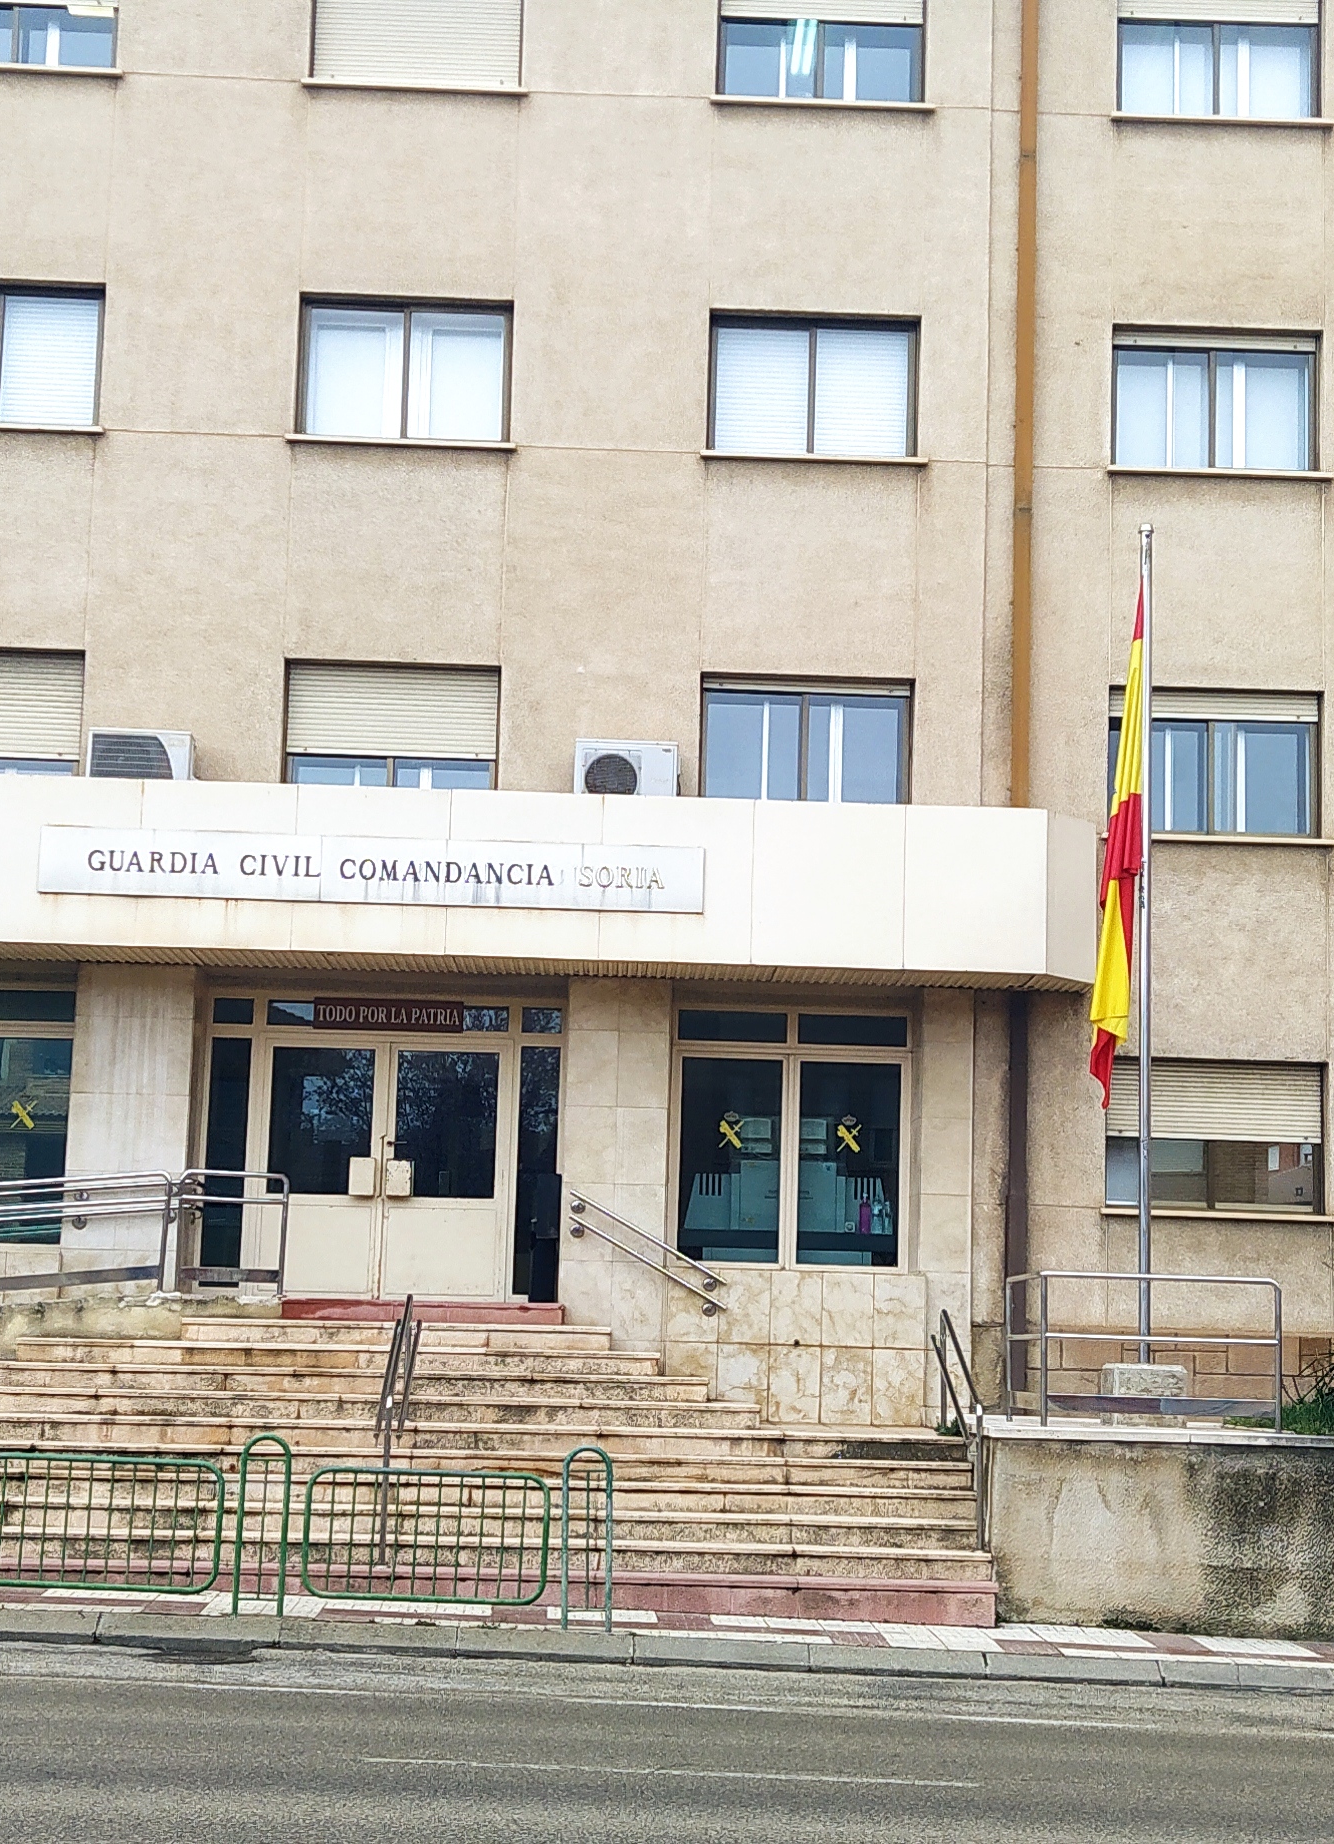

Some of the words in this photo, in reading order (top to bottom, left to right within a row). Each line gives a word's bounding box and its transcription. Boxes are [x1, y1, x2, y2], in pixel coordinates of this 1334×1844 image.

[87, 849, 219, 875] GUARDIA
[239, 854, 321, 878] CIVIL
[339, 858, 555, 886] COMANDANCIA
[578, 865, 666, 890] SORIA
[317, 1004, 356, 1022] TODO
[359, 1005, 388, 1024] POR
[390, 1007, 408, 1024] LA
[410, 1007, 460, 1026] PATRIA
